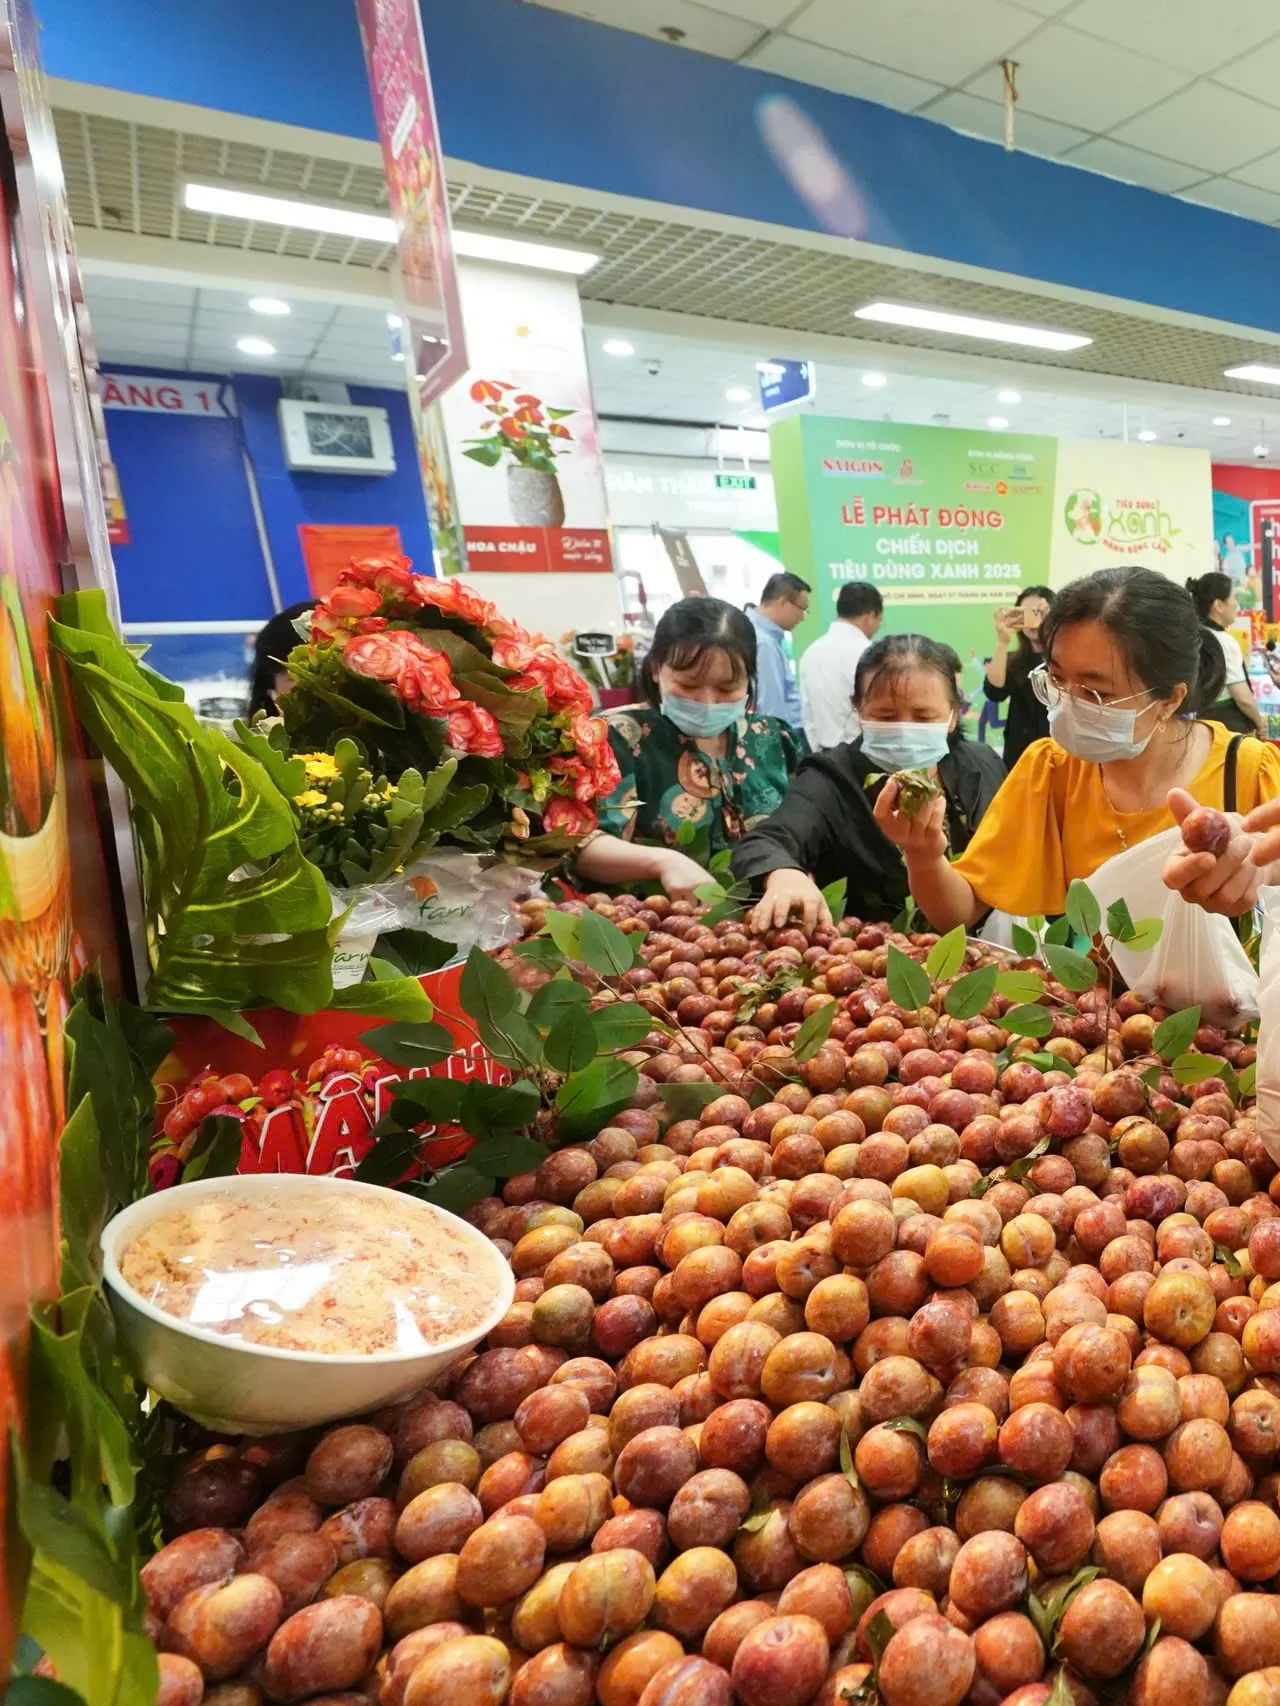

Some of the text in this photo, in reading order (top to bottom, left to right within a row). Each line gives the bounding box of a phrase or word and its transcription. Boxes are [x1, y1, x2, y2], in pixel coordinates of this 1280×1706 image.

[195, 390, 210, 412] 1
[720, 475, 751, 489] EXIT
[842, 495, 1004, 533] LỄ PHÁT ĐỘNG
[876, 534, 980, 559] CHIẾN DỊCH
[872, 560, 926, 580] DÙNG
[931, 563, 979, 580] XANH
[983, 563, 1022, 579] 2025
